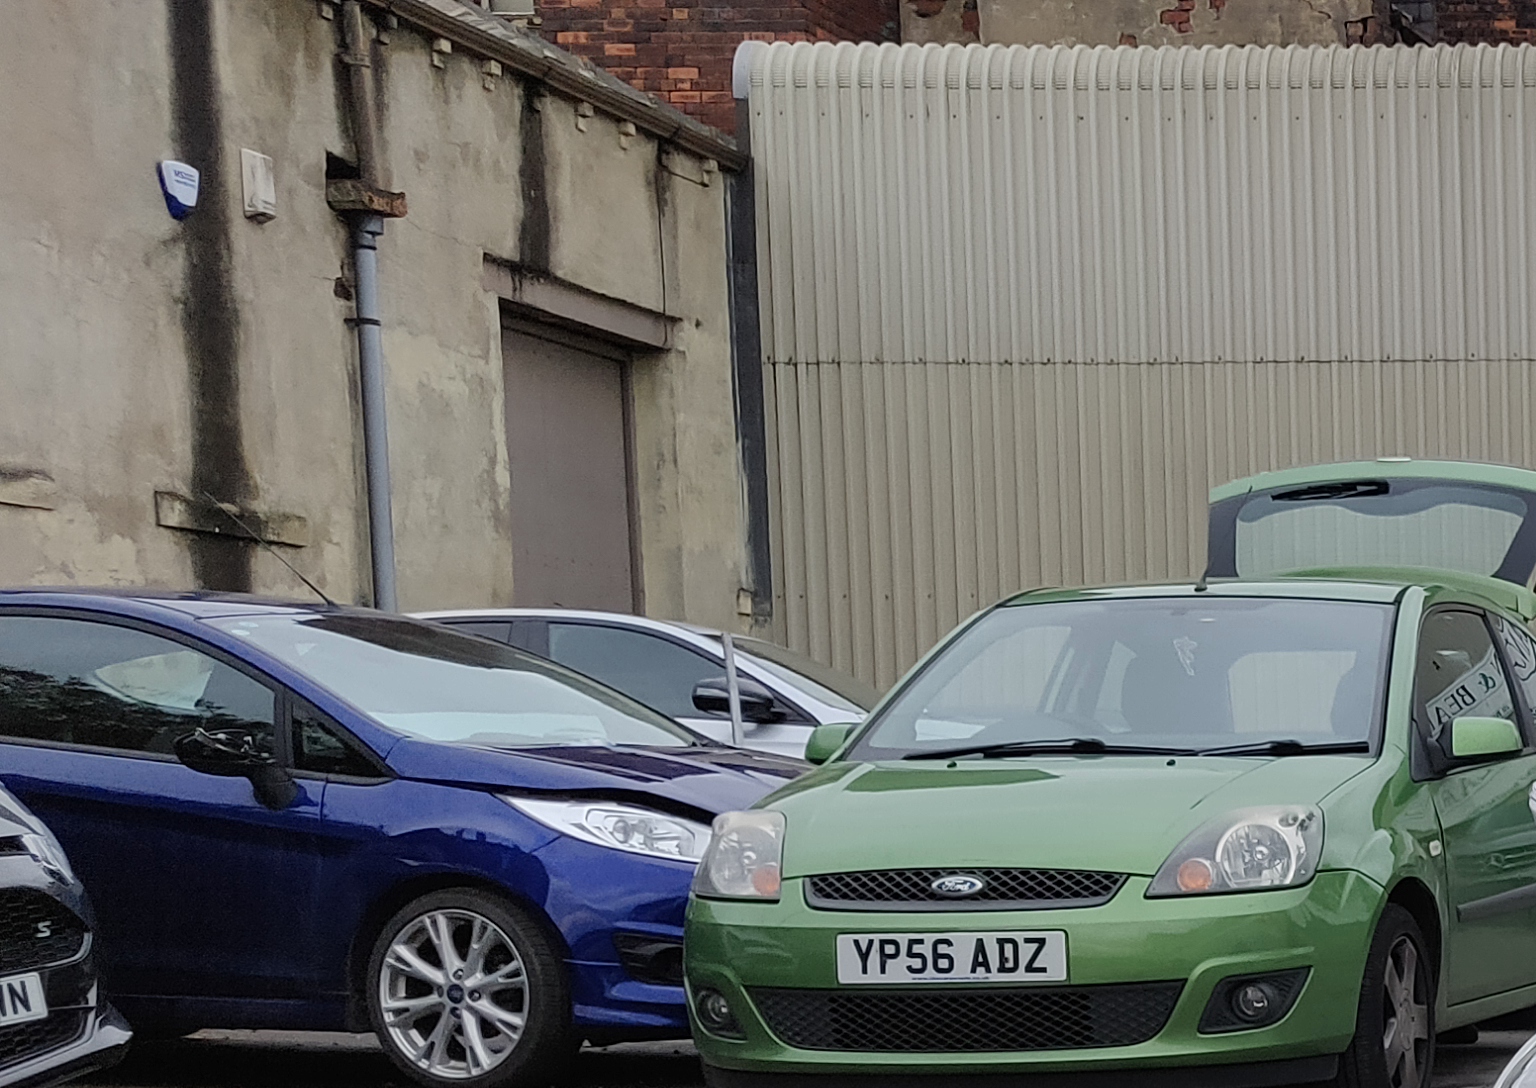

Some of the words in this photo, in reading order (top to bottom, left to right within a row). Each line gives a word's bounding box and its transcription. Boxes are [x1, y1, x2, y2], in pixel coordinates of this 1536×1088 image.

[941, 879, 972, 892] Ford
[853, 938, 955, 975] YP56
[970, 937, 1048, 974] ADZ
